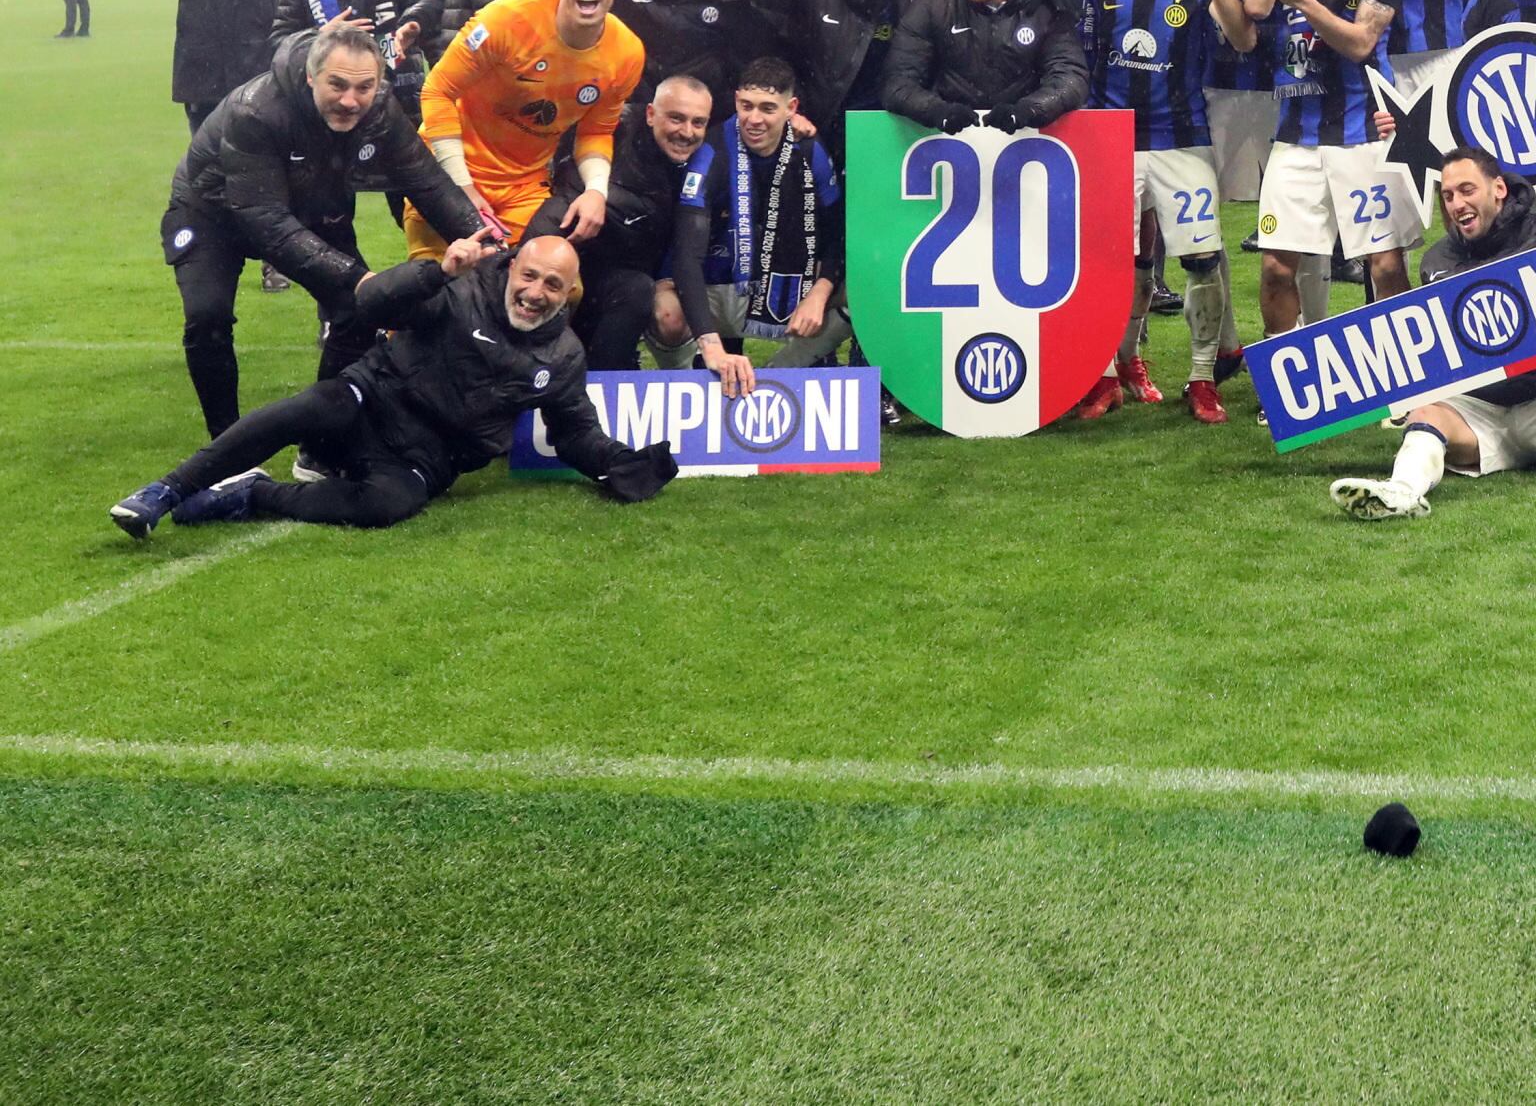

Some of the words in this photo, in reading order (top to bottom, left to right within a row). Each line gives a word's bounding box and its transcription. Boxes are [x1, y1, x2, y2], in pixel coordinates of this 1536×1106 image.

[1107, 51, 1174, 73] Paramount+
[803, 193, 816, 233] 1962-1963
[900, 133, 1082, 313] 20
[1172, 187, 1215, 225] 22
[1349, 183, 1393, 225] 23
